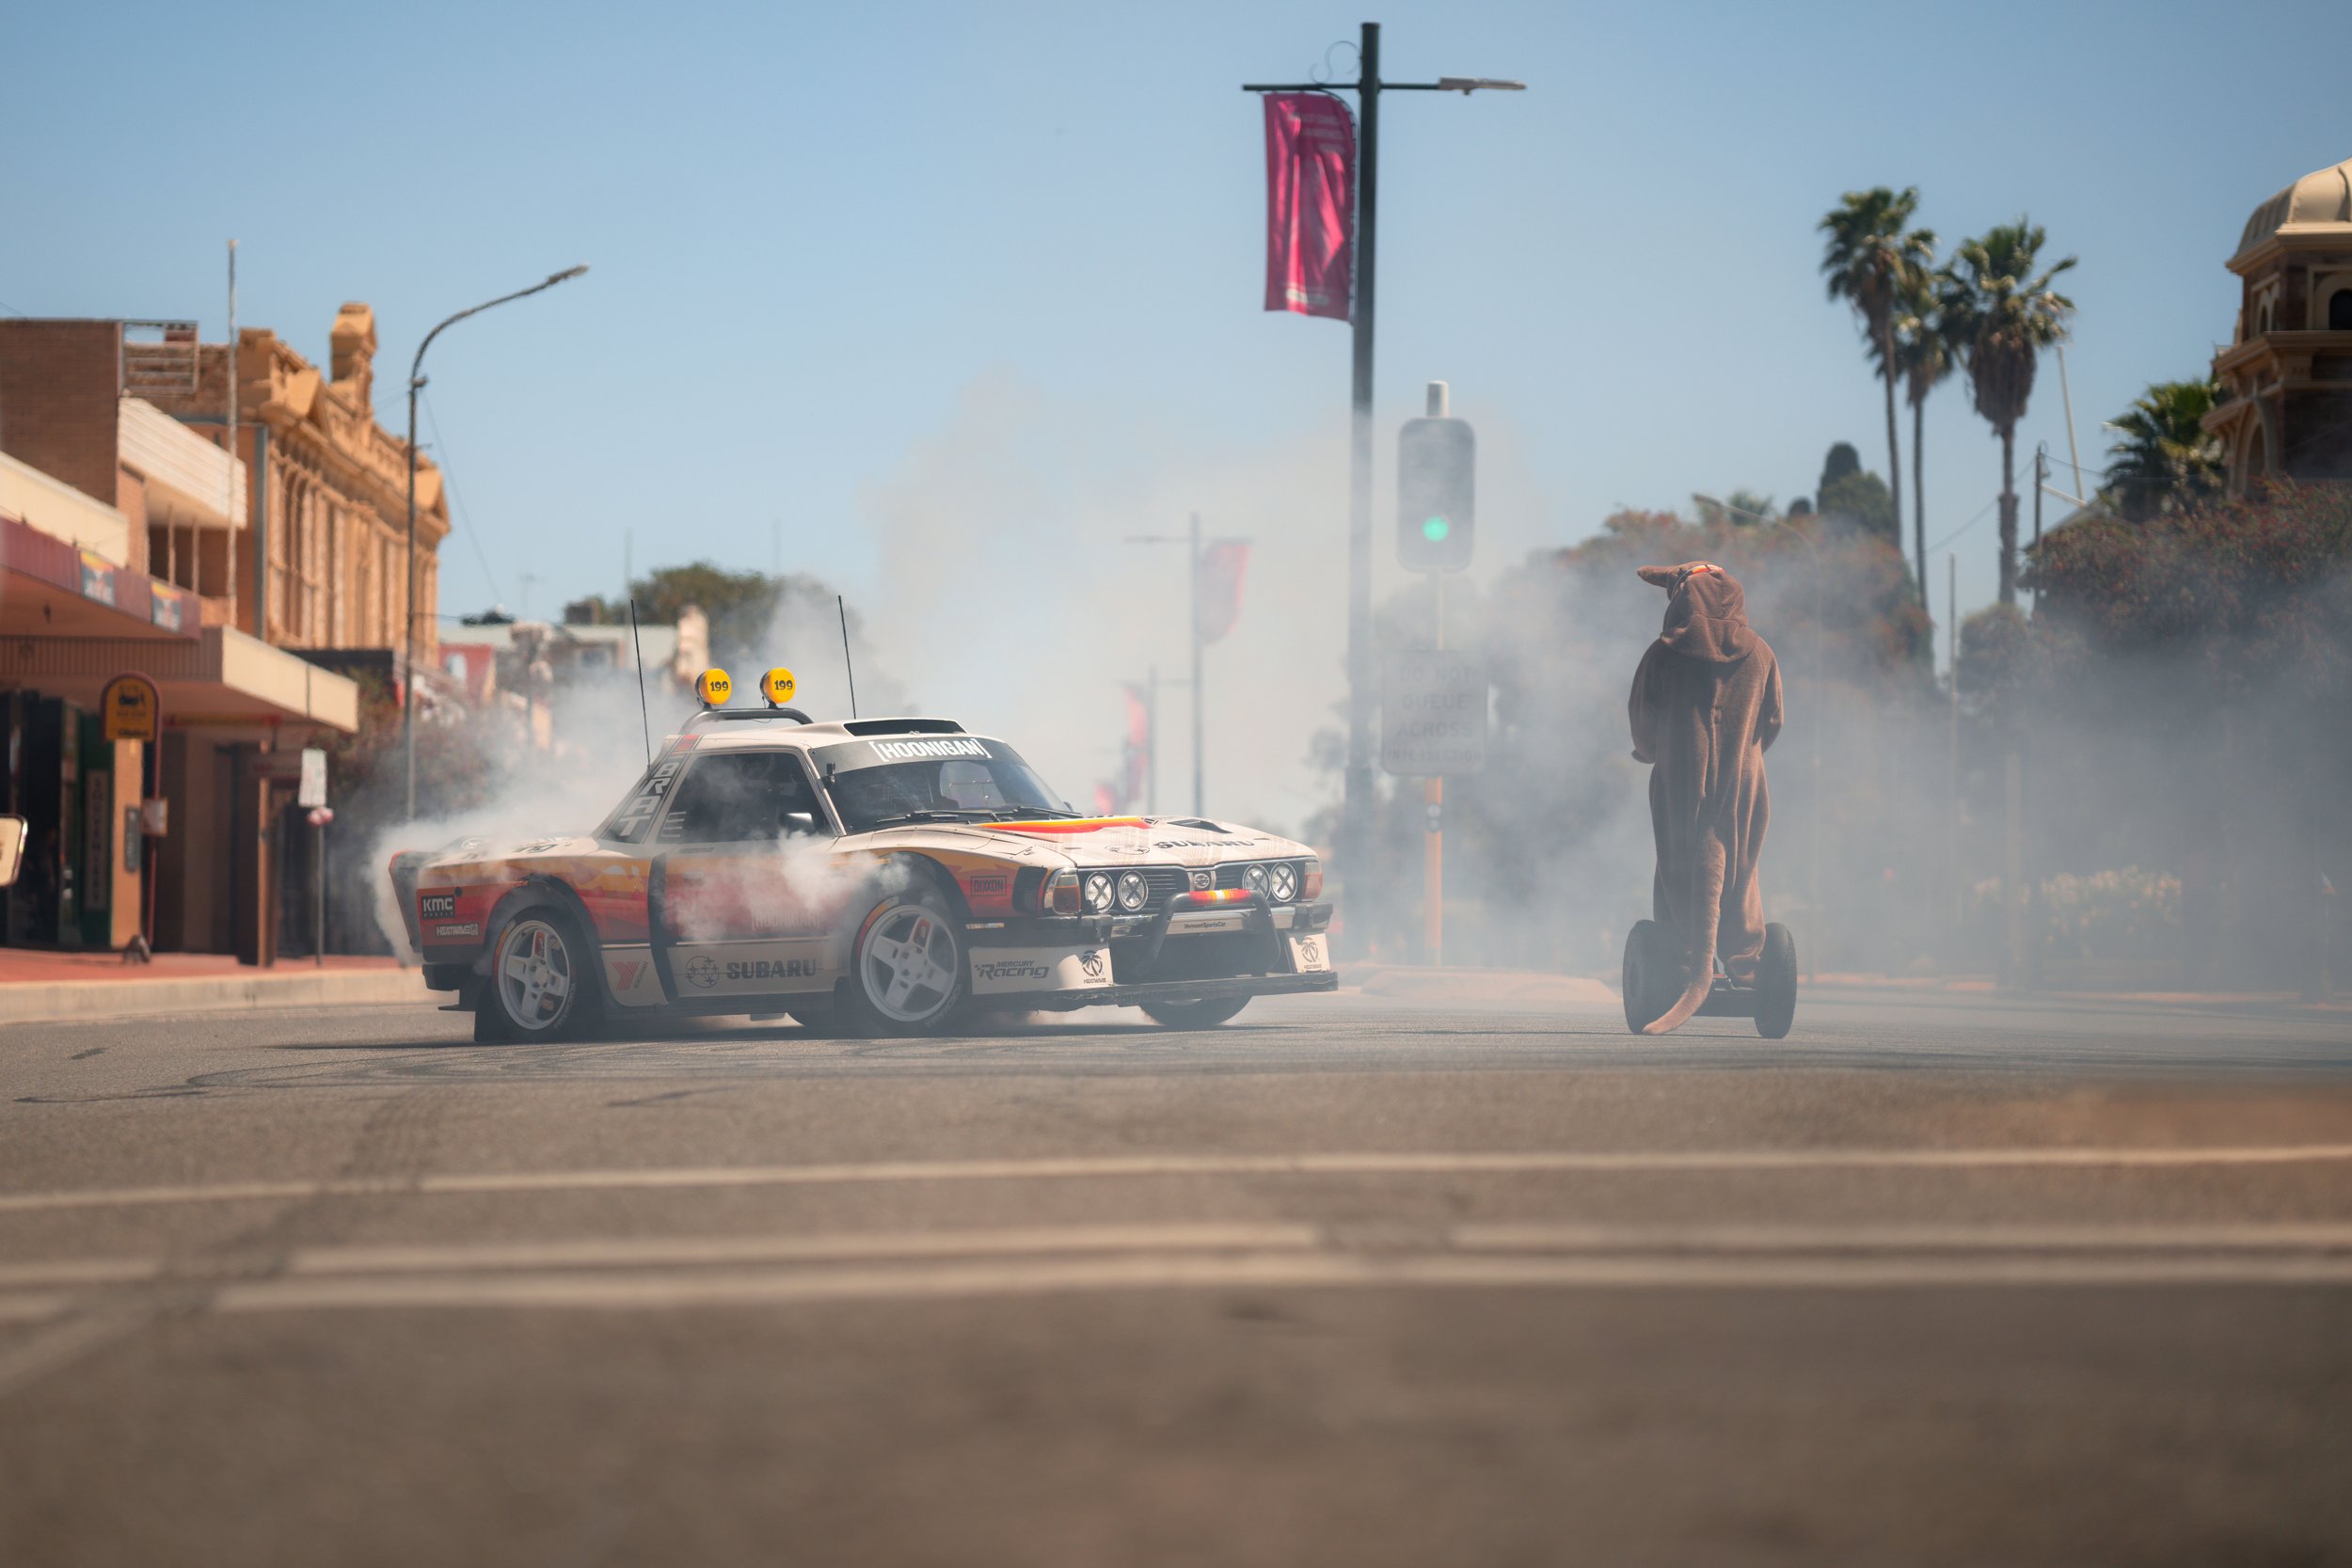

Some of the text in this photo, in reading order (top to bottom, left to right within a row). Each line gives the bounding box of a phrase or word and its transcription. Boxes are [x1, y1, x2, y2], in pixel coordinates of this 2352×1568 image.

[1400, 666, 1472, 682] DO NOT
[710, 680, 729, 692] 199
[774, 679, 793, 691] 199
[1401, 693, 1469, 710] QUEUE
[1396, 721, 1473, 738] ACROSS
[619, 761, 680, 836] BRAT
[974, 879, 1004, 893] DIXXON
[726, 958, 817, 980] SUBARU
[996, 959, 1034, 968] MERCURY
[978, 964, 1050, 980] Racing
